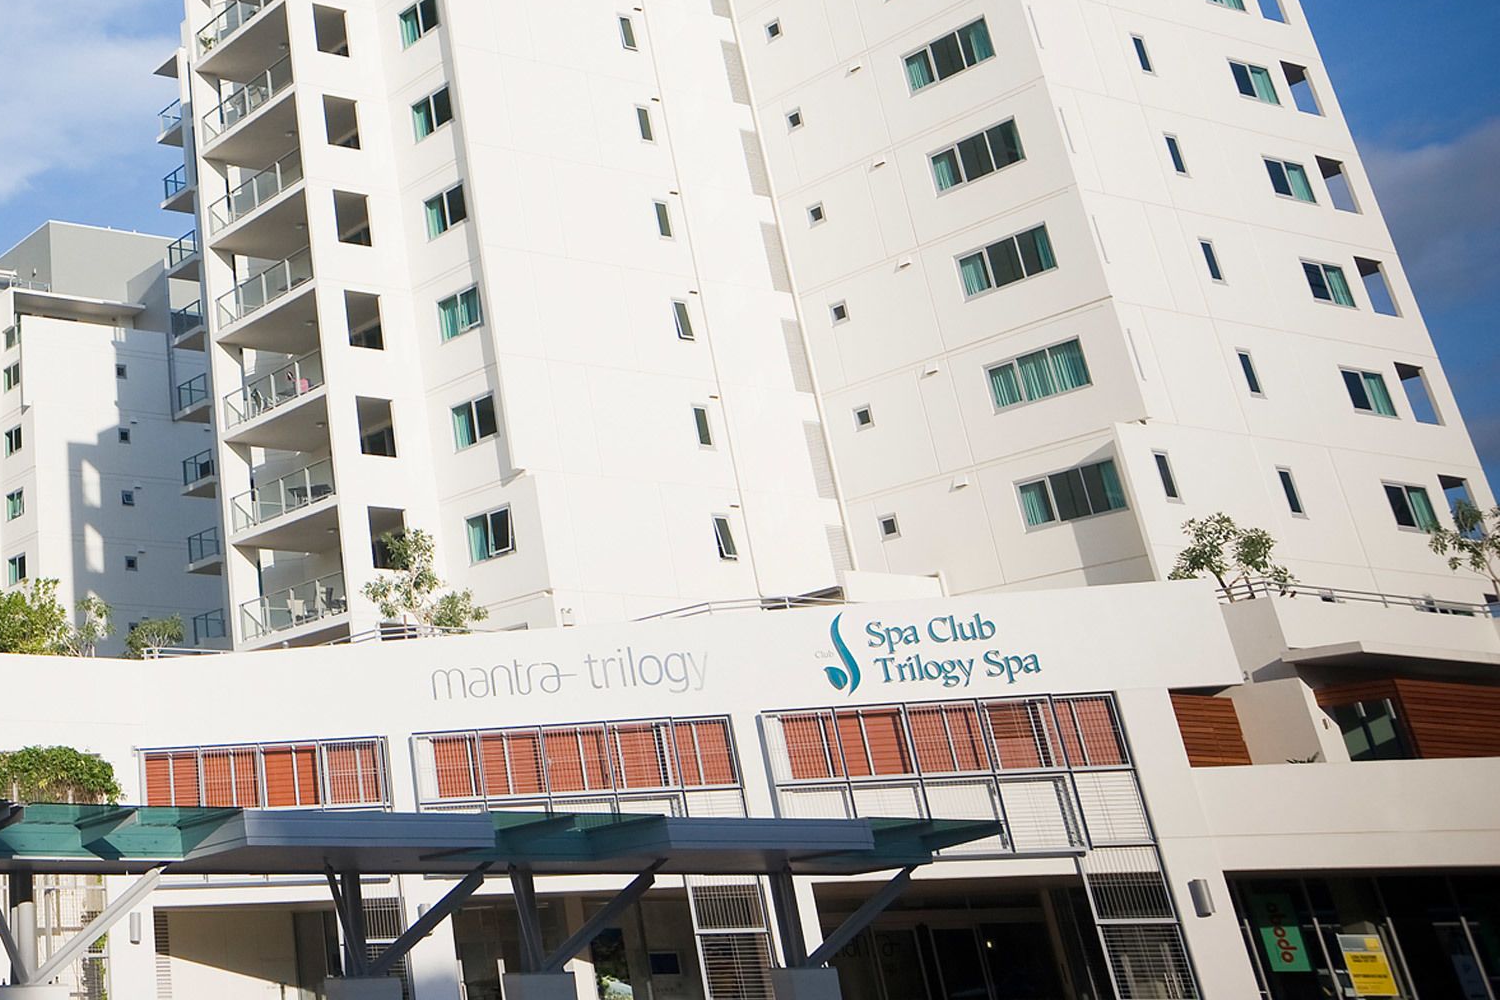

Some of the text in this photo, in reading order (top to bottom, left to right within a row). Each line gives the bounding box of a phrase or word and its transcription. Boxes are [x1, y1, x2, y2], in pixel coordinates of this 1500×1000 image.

[865, 612, 997, 654] Spa Club
[583, 646, 708, 693] trilogy
[873, 649, 1042, 688] Trilogy Spa
